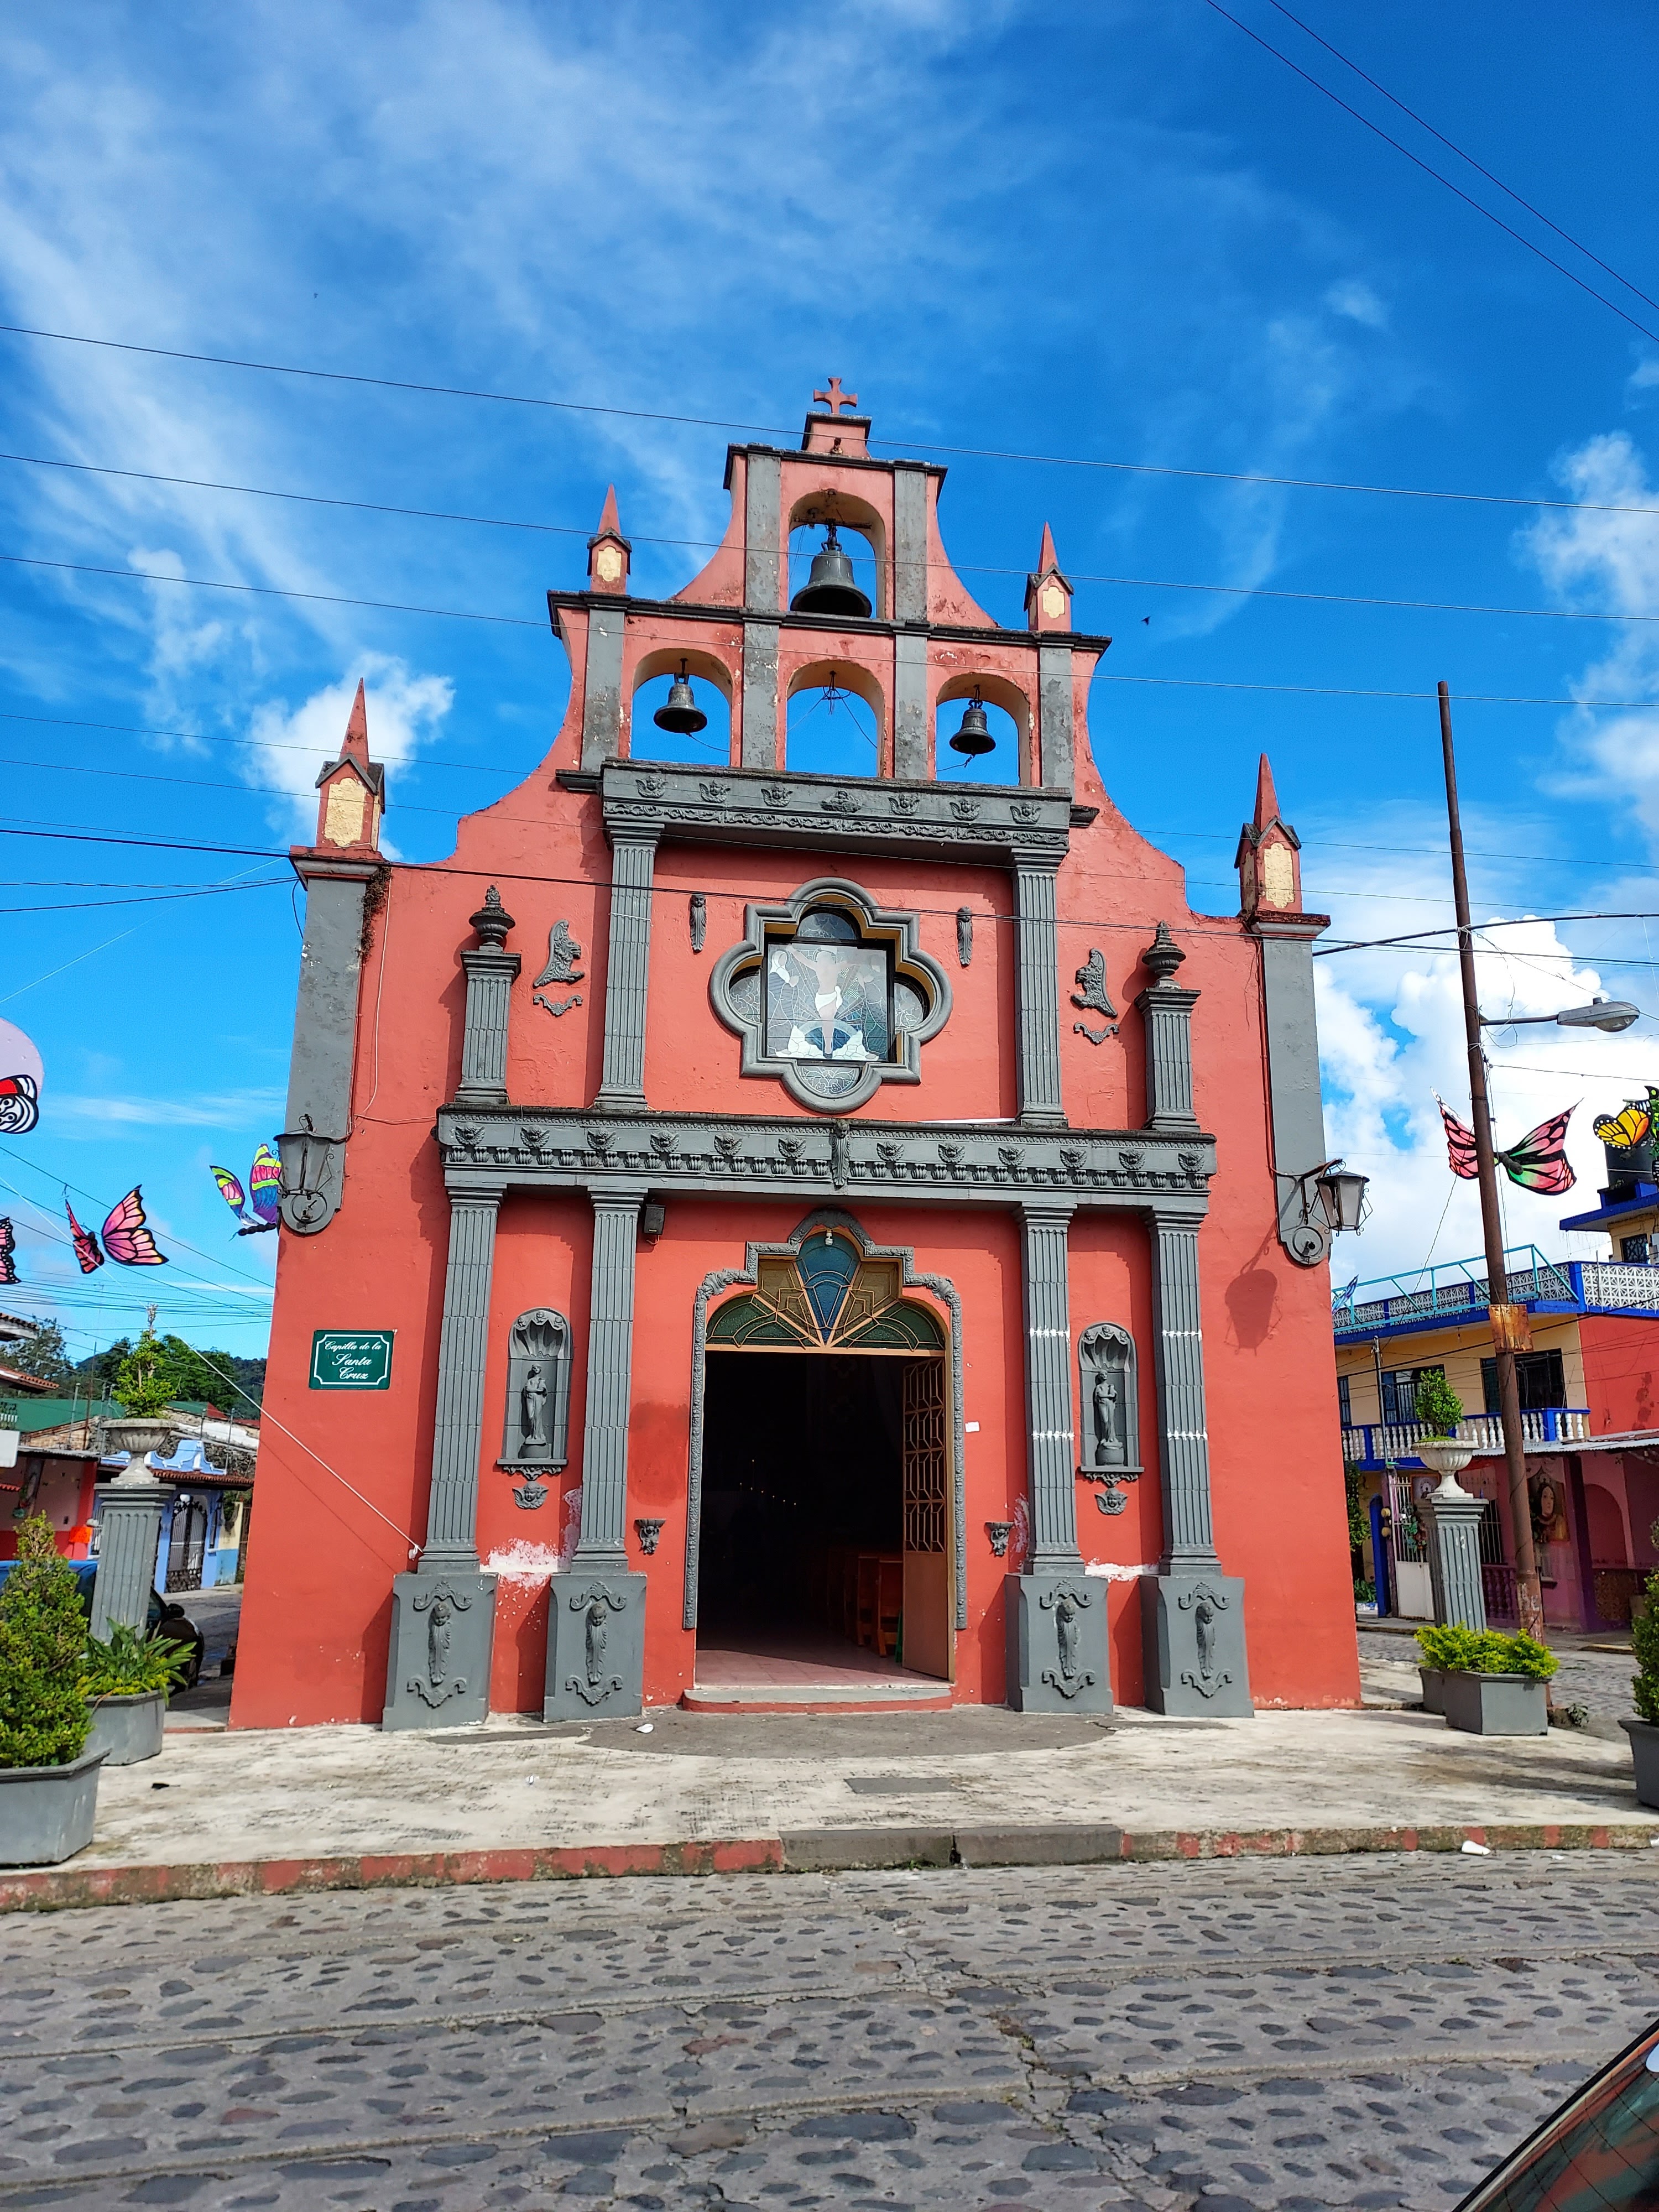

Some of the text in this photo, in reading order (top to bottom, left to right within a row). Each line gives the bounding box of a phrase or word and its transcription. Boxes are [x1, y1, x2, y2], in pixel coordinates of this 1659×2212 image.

[325, 1341, 357, 1352] Capilla
[371, 1341, 382, 1350] la
[332, 1353, 372, 1365] Santa
[339, 1367, 369, 1379] Cruz
